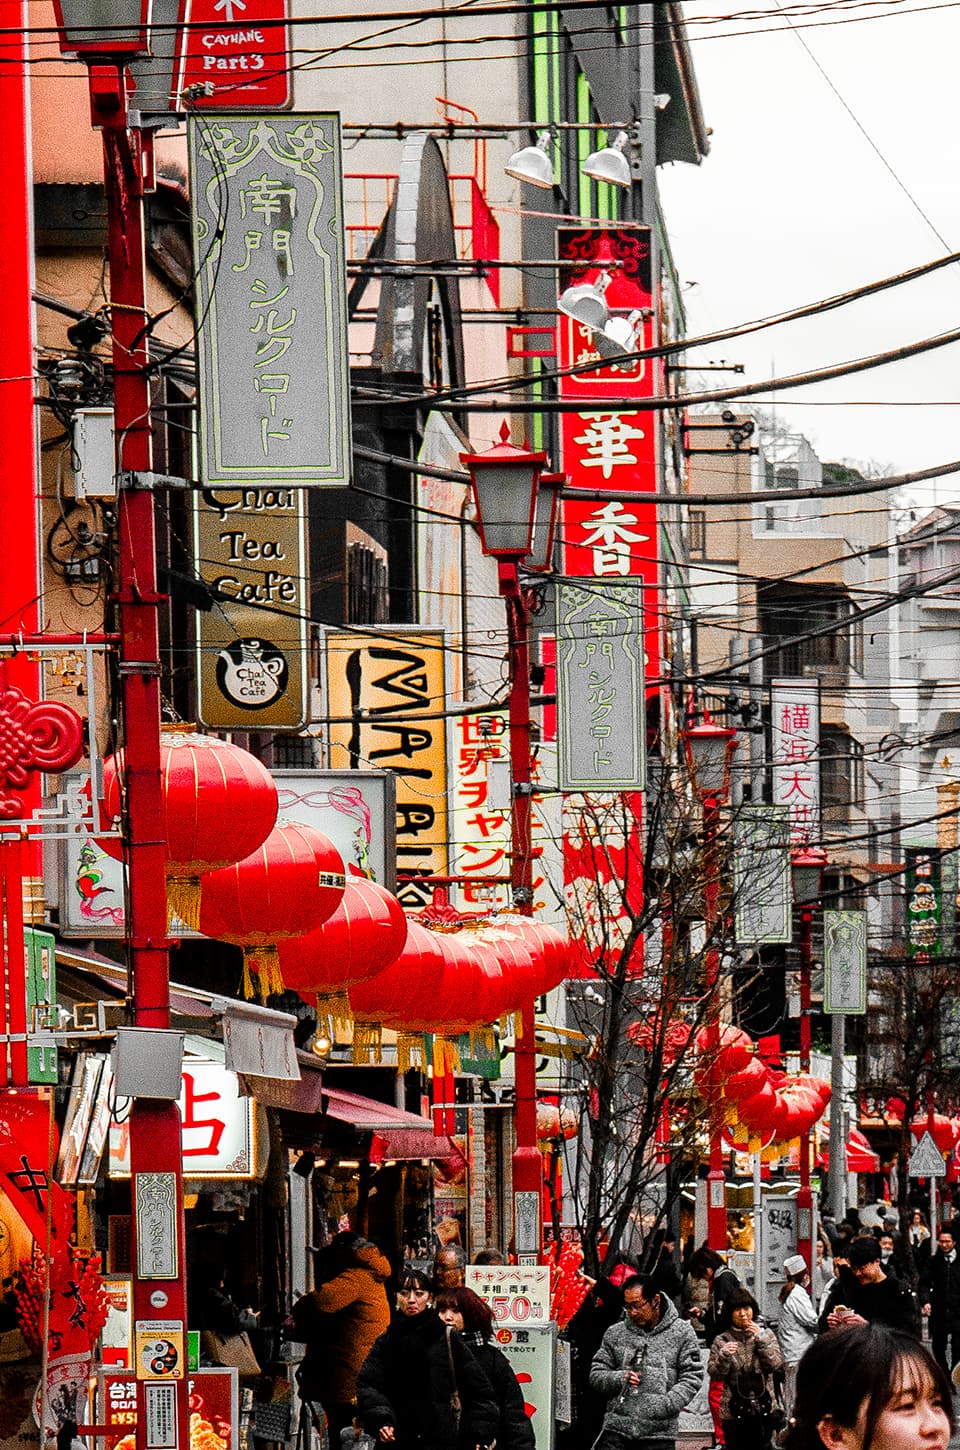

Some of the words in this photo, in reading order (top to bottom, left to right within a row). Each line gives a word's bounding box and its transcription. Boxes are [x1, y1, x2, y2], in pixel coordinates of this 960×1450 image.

[231, 173, 297, 457] 南門シルクロード
[219, 531, 286, 562] Tea
[212, 571, 298, 604] Café
[579, 610, 620, 773] 南門シルクロード
[471, 1270, 546, 1282] キャンペーン
